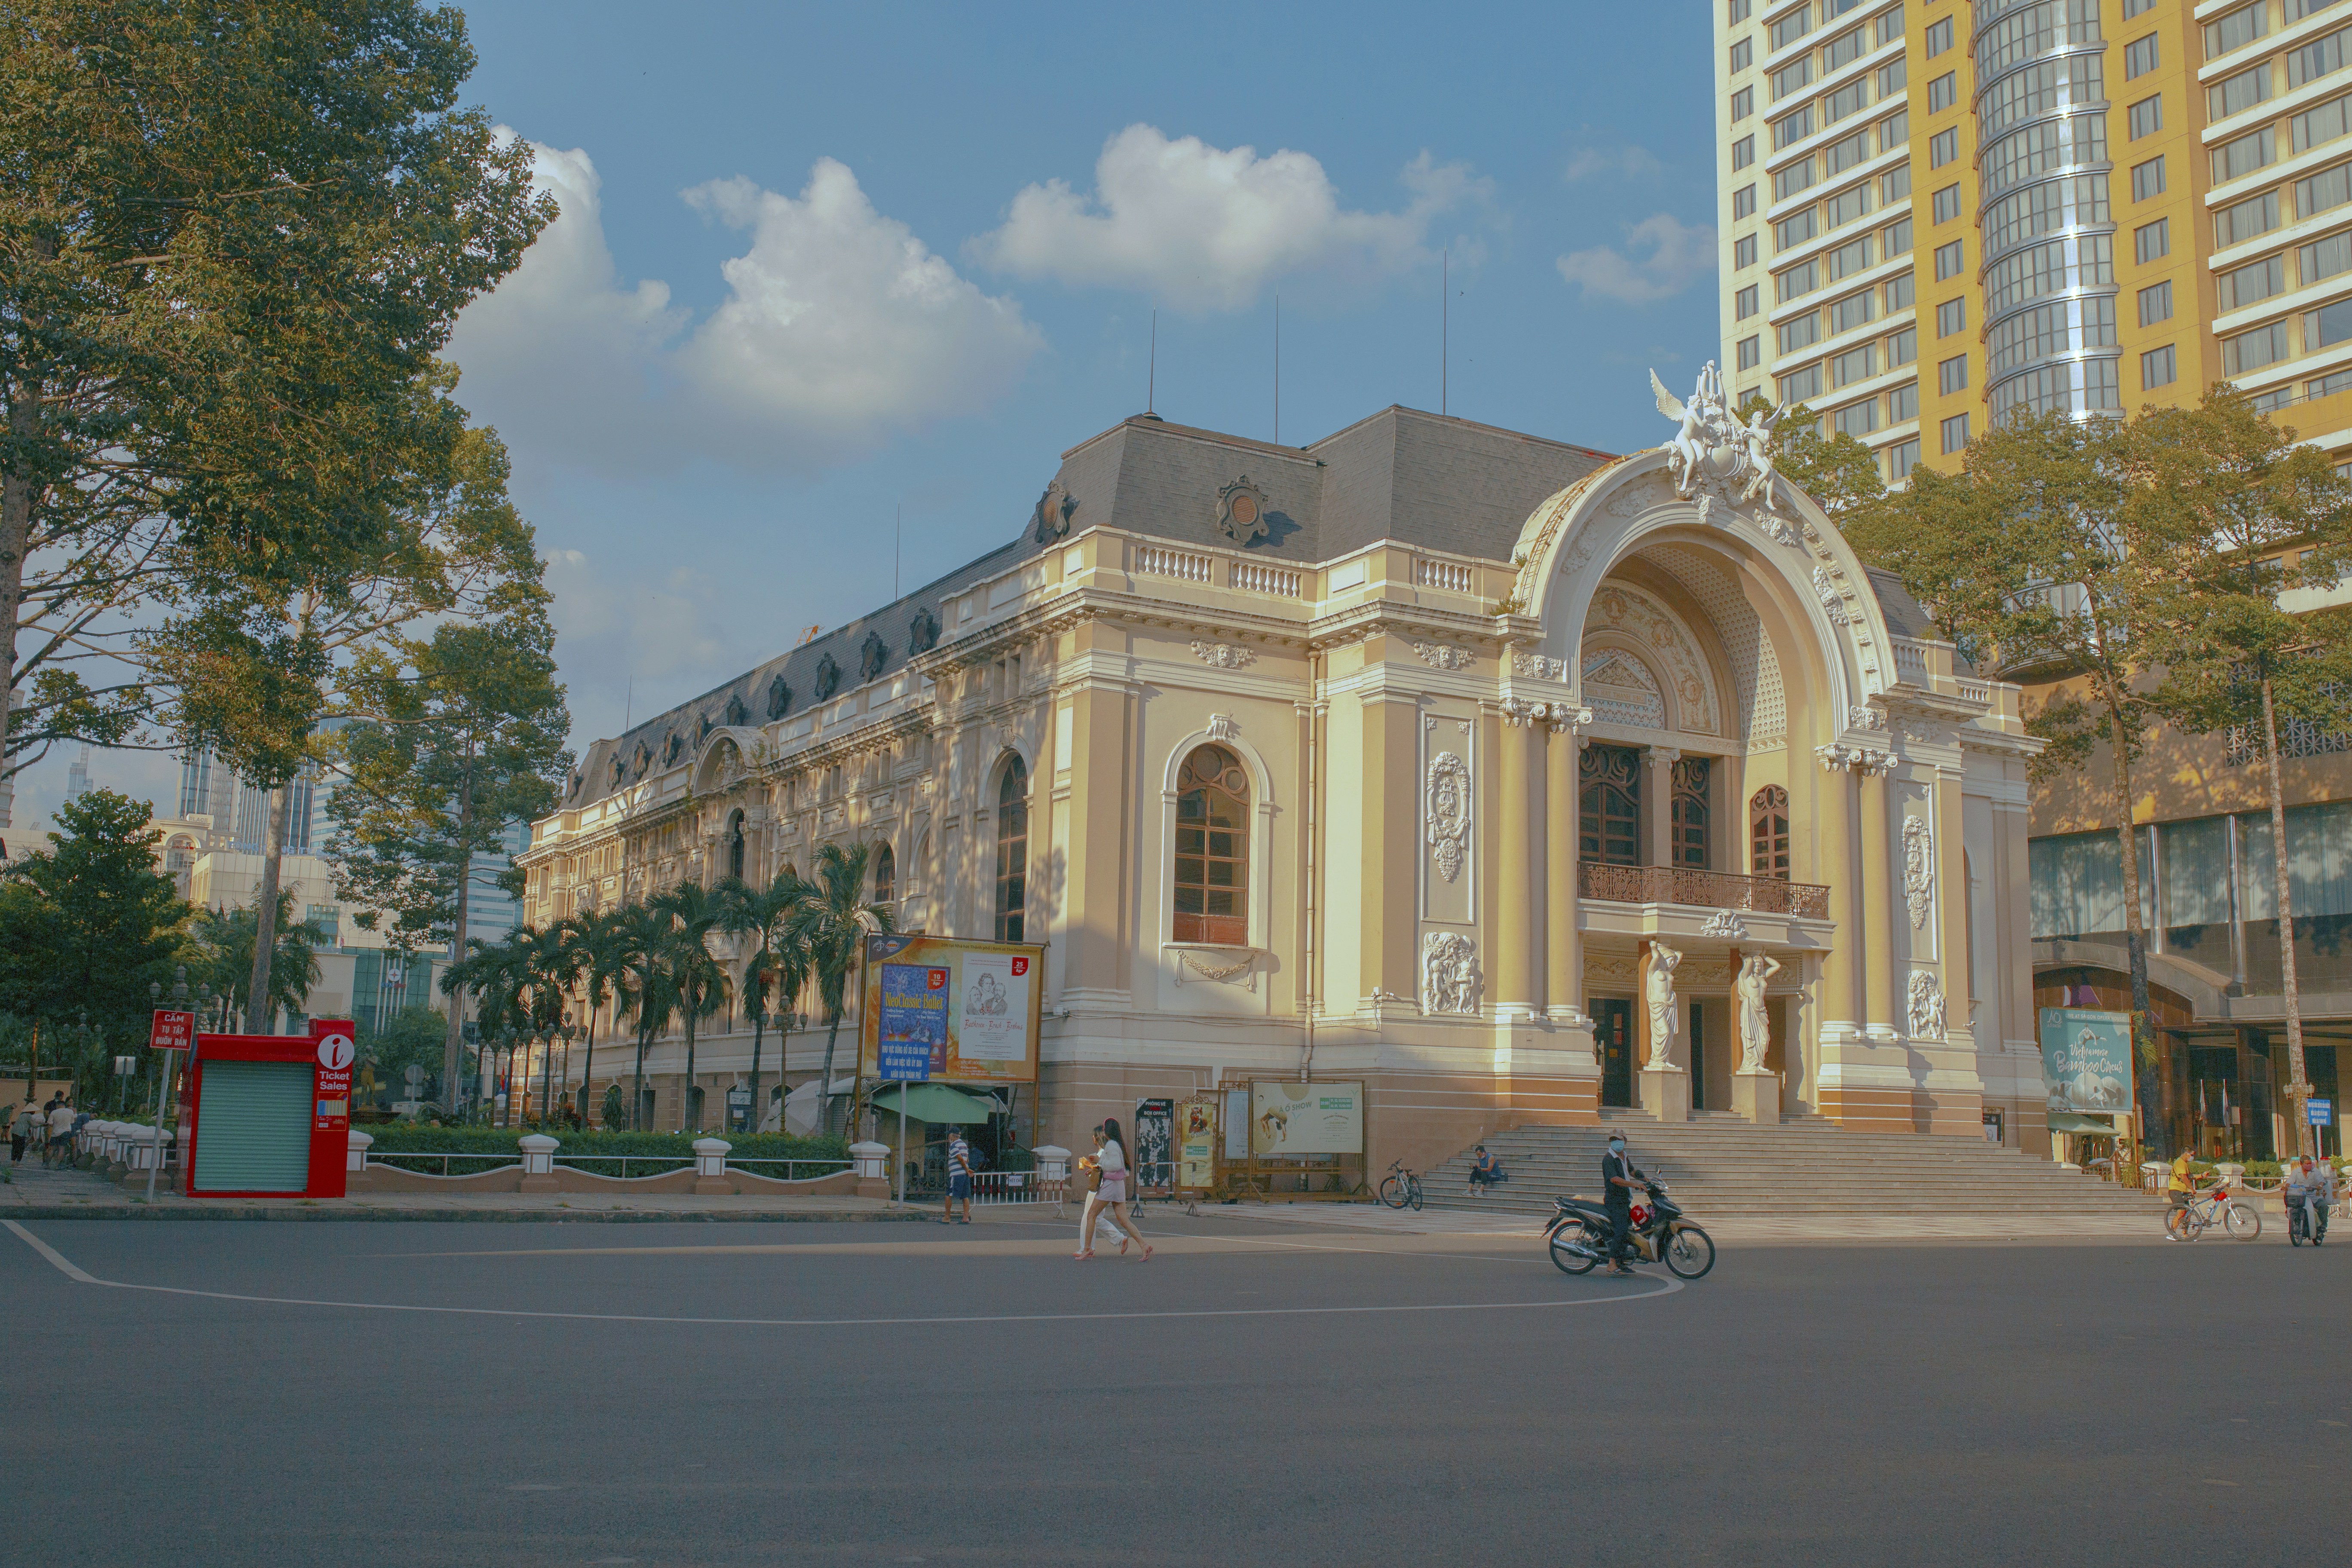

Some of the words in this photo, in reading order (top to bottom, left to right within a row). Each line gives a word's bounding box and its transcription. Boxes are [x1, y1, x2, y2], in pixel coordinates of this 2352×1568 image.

[885, 992, 921, 1008] NeoClassic
[923, 993, 943, 1009] Ballet
[165, 1012, 184, 1023] CẤM
[162, 1025, 170, 1034] TỤ
[173, 1025, 184, 1035] TẬP
[964, 1019, 985, 1029] Beethoven
[988, 1020, 1002, 1031] Bruch
[1006, 1021, 1023, 1032] Brahms
[156, 1035, 172, 1045] BUÔN
[175, 1036, 187, 1046] BÁN
[2069, 1041, 2108, 1060] Vietnamese
[2053, 1050, 2099, 1073] Bamboo
[2100, 1058, 2122, 1073] Circus
[319, 1071, 349, 1080] Ticket
[320, 1081, 347, 1090] Sales
[1292, 1101, 1312, 1111] SHOW
